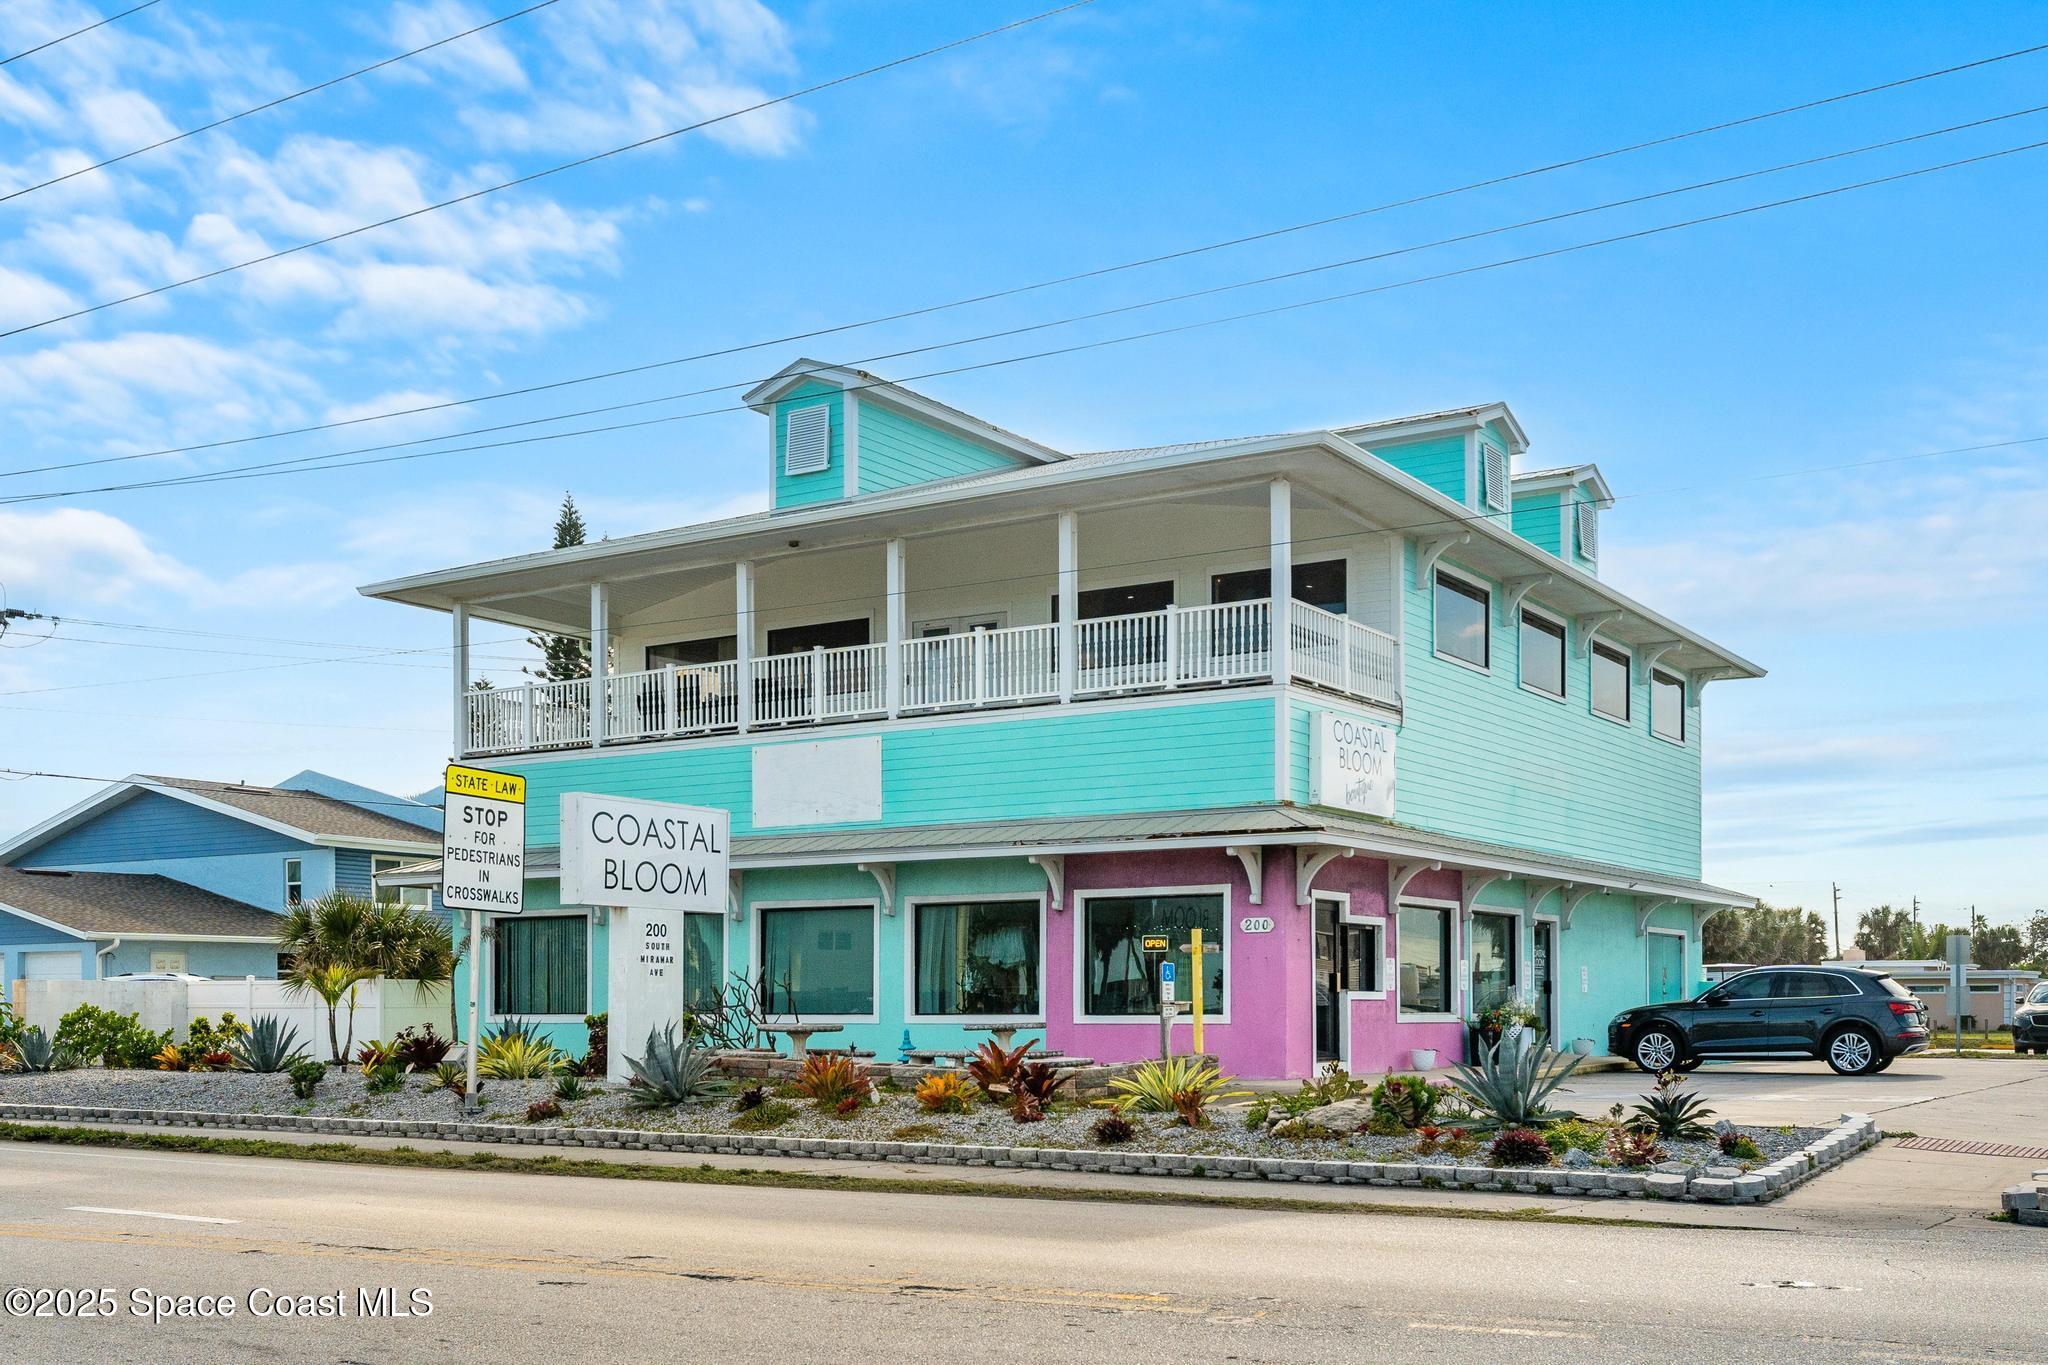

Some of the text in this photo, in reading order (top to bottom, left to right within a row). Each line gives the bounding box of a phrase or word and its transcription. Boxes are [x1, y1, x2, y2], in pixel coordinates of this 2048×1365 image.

[1333, 719, 1387, 753] COASTAL
[1339, 747, 1383, 776] BLOOM
[455, 774, 517, 796] STATE LAW
[463, 805, 509, 827] STOP
[474, 832, 496, 846] FOR
[591, 810, 721, 854] COASTAL
[447, 846, 521, 868] PEDESTRIANS
[479, 869, 490, 883] IN
[604, 858, 707, 896] BLOOM
[446, 885, 520, 905] CROSSWALKS
[645, 922, 667, 937] 200
[1244, 918, 1269, 931] 200
[645, 942, 670, 951] SOUTH
[1145, 938, 1166, 948] OPEN
[640, 955, 674, 964] MIRAMAR
[649, 968, 664, 977] AVE
